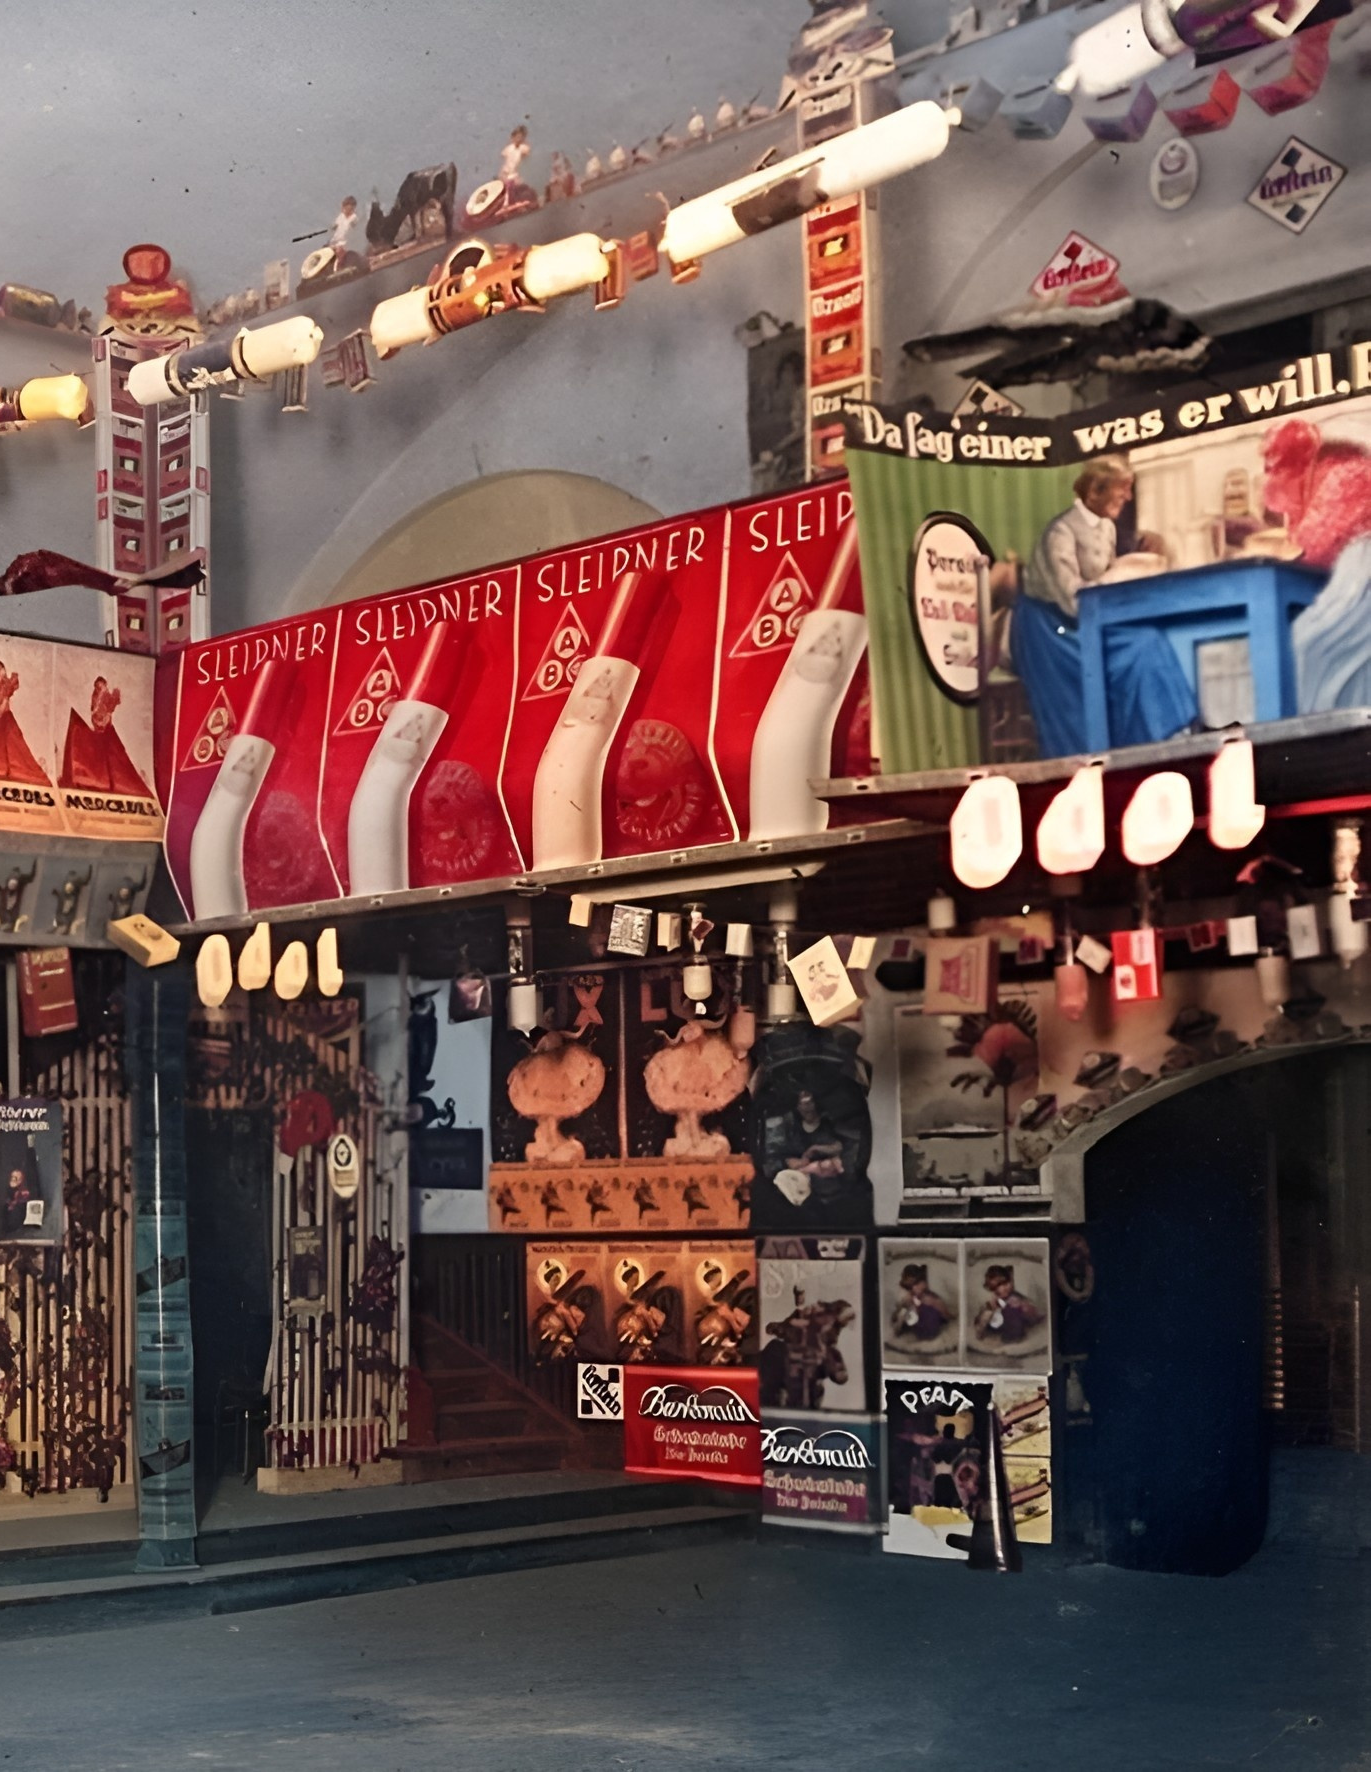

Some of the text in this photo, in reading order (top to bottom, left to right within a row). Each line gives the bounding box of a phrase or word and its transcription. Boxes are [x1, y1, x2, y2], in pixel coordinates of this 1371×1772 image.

[862, 404, 904, 449] Da
[960, 421, 1052, 461] einer
[1073, 408, 1165, 454] was
[1178, 393, 1232, 428] er
[1237, 352, 1351, 414] will.
